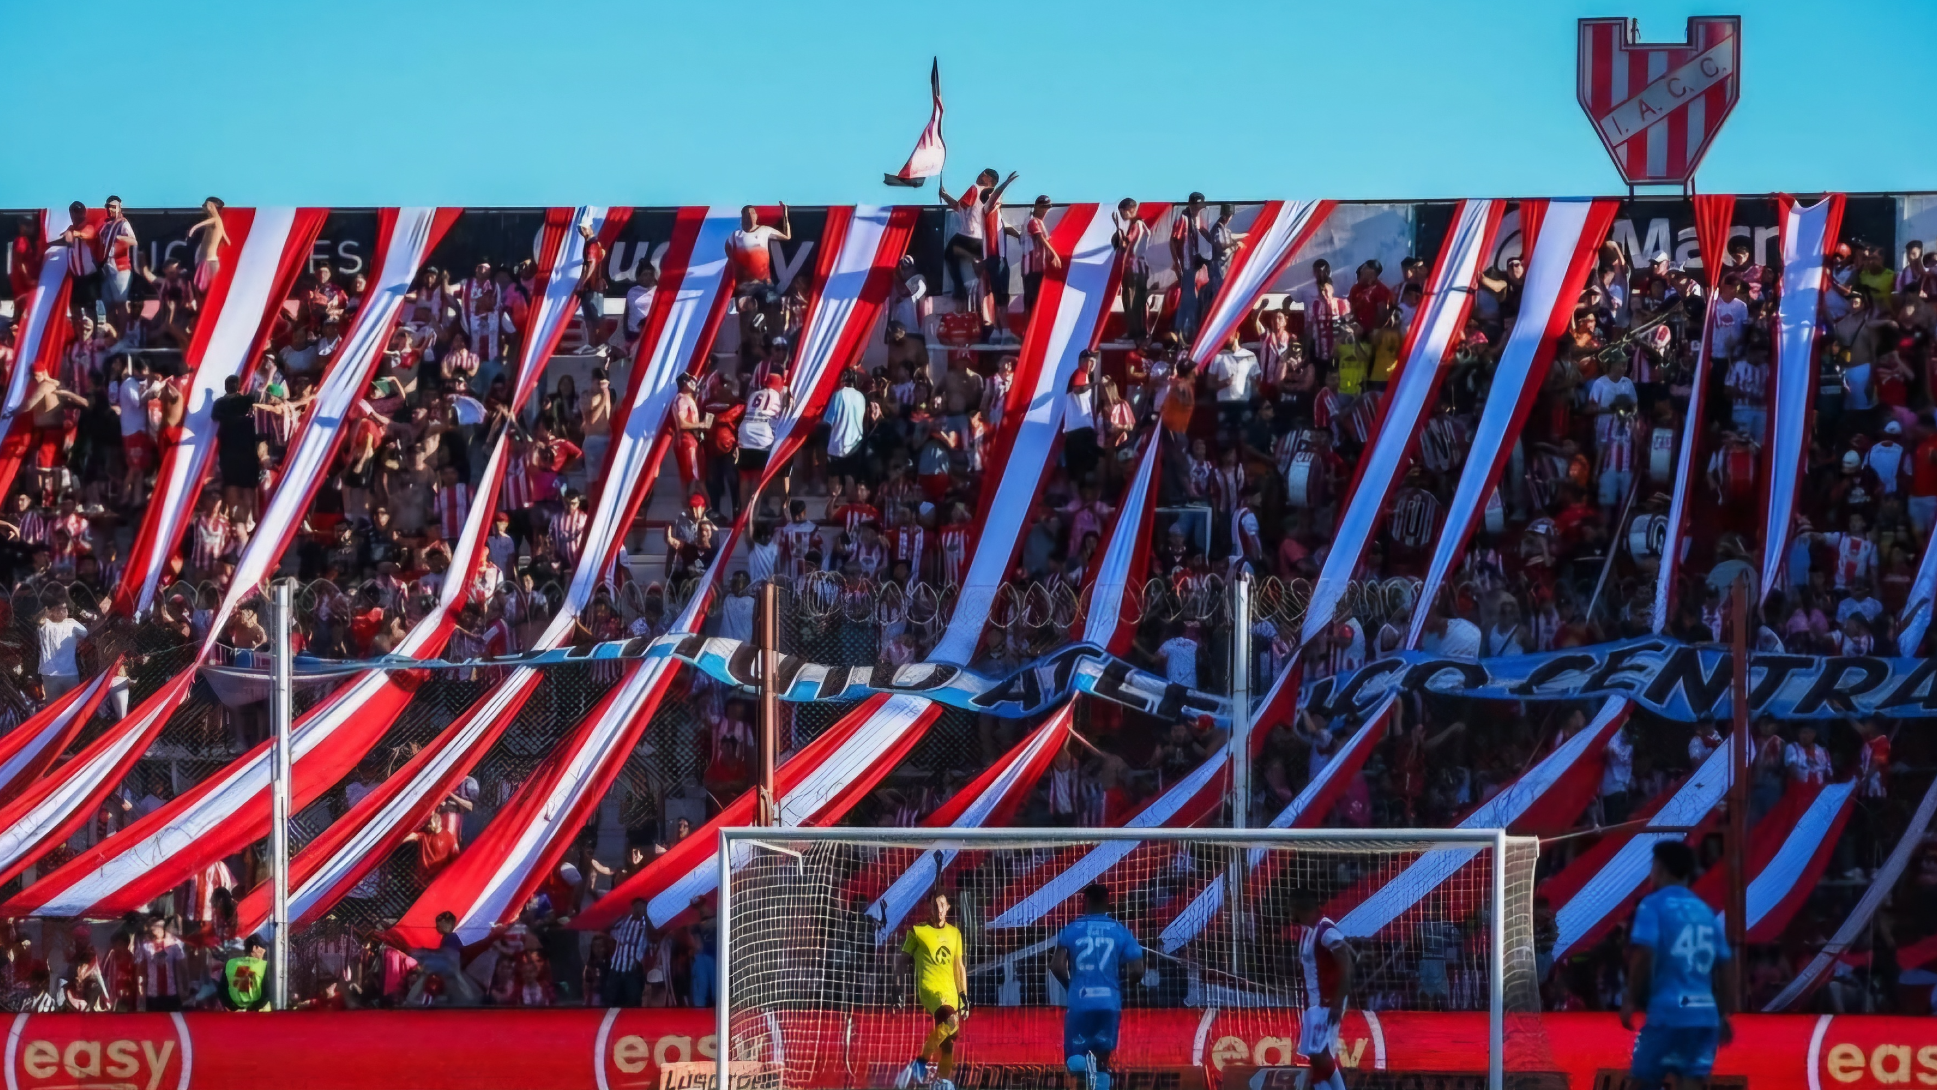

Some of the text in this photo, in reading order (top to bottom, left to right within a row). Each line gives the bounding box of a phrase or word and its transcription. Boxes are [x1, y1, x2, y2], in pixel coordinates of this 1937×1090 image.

[1075, 935, 1115, 971] 27
[1670, 924, 1716, 976] 45
[24, 1039, 175, 1090] easy
[1212, 1036, 1368, 1073] eay
